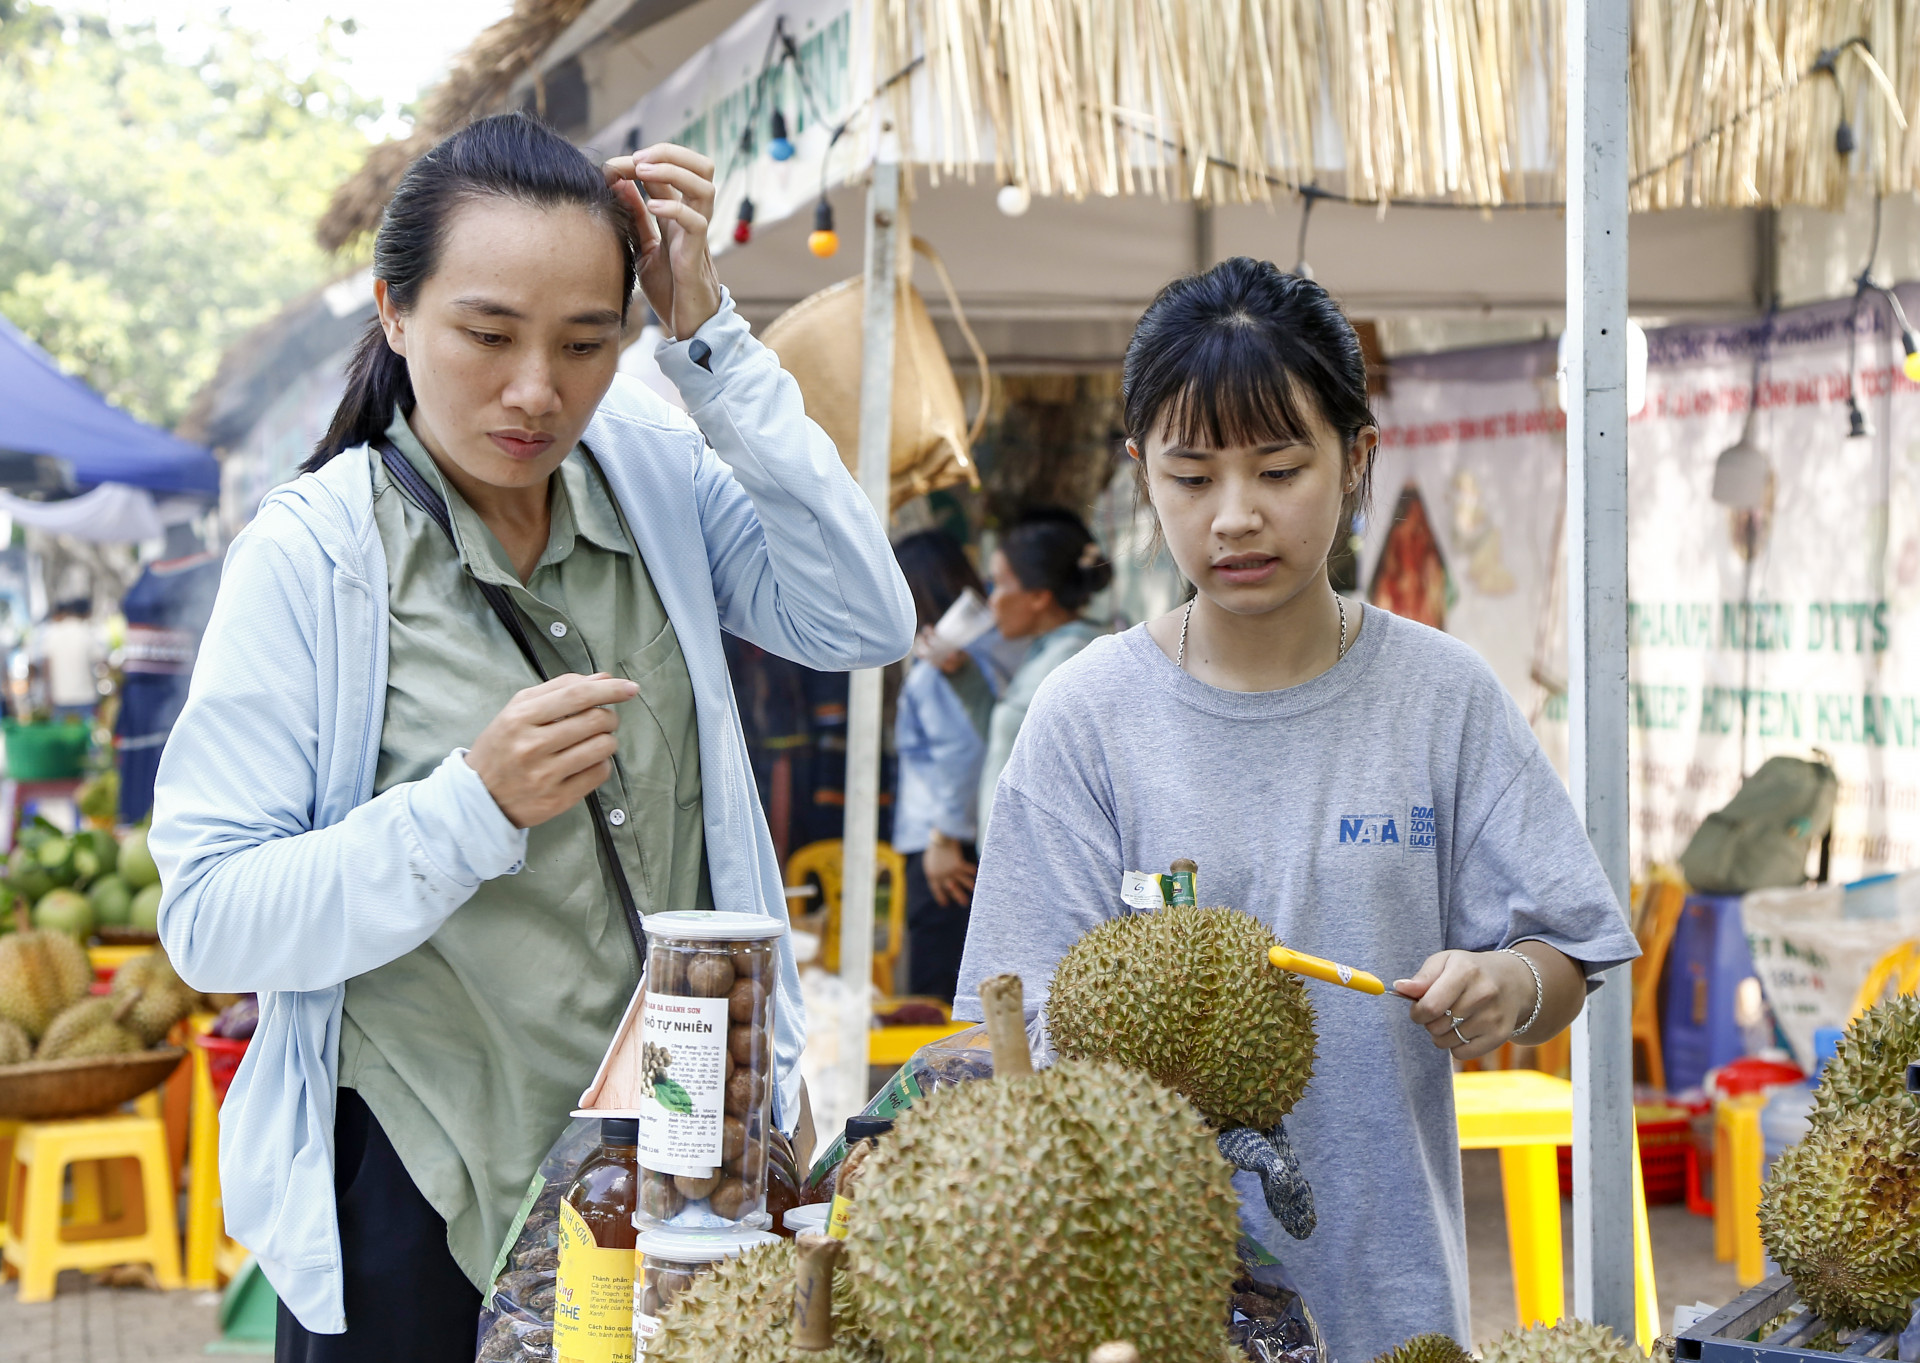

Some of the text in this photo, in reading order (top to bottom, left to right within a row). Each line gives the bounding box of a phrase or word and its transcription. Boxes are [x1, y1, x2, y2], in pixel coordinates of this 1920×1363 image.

[1339, 819, 1399, 843] NATA
[657, 1019, 672, 1033] TỰ
[673, 1019, 713, 1034] NHIÊN
[572, 1221, 590, 1246] SƠN
